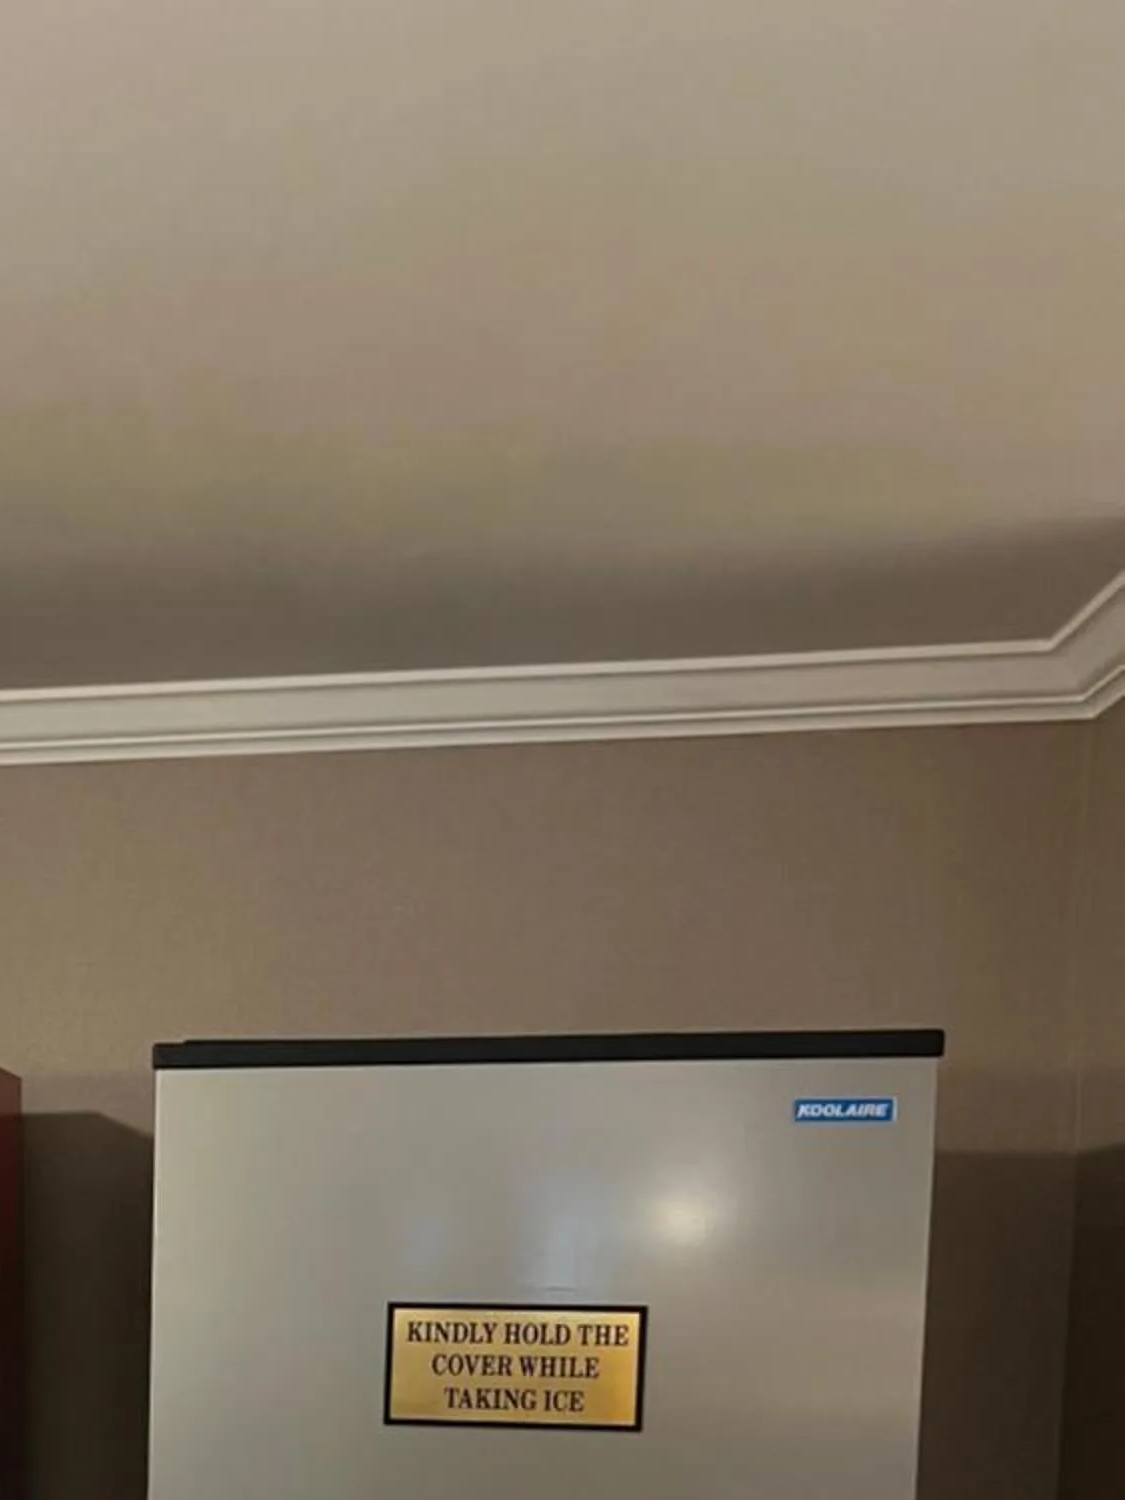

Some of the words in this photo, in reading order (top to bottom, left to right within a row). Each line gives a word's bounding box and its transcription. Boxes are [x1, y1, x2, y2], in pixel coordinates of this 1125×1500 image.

[796, 1102, 892, 1119] KOOLAIRE
[407, 1321, 498, 1344] KINDLY
[504, 1323, 572, 1346] HOLD
[578, 1324, 629, 1347] THE
[431, 1353, 513, 1377] COVER
[519, 1356, 600, 1379] WHILE
[444, 1386, 537, 1411] TAKING
[544, 1389, 585, 1412] ICE
